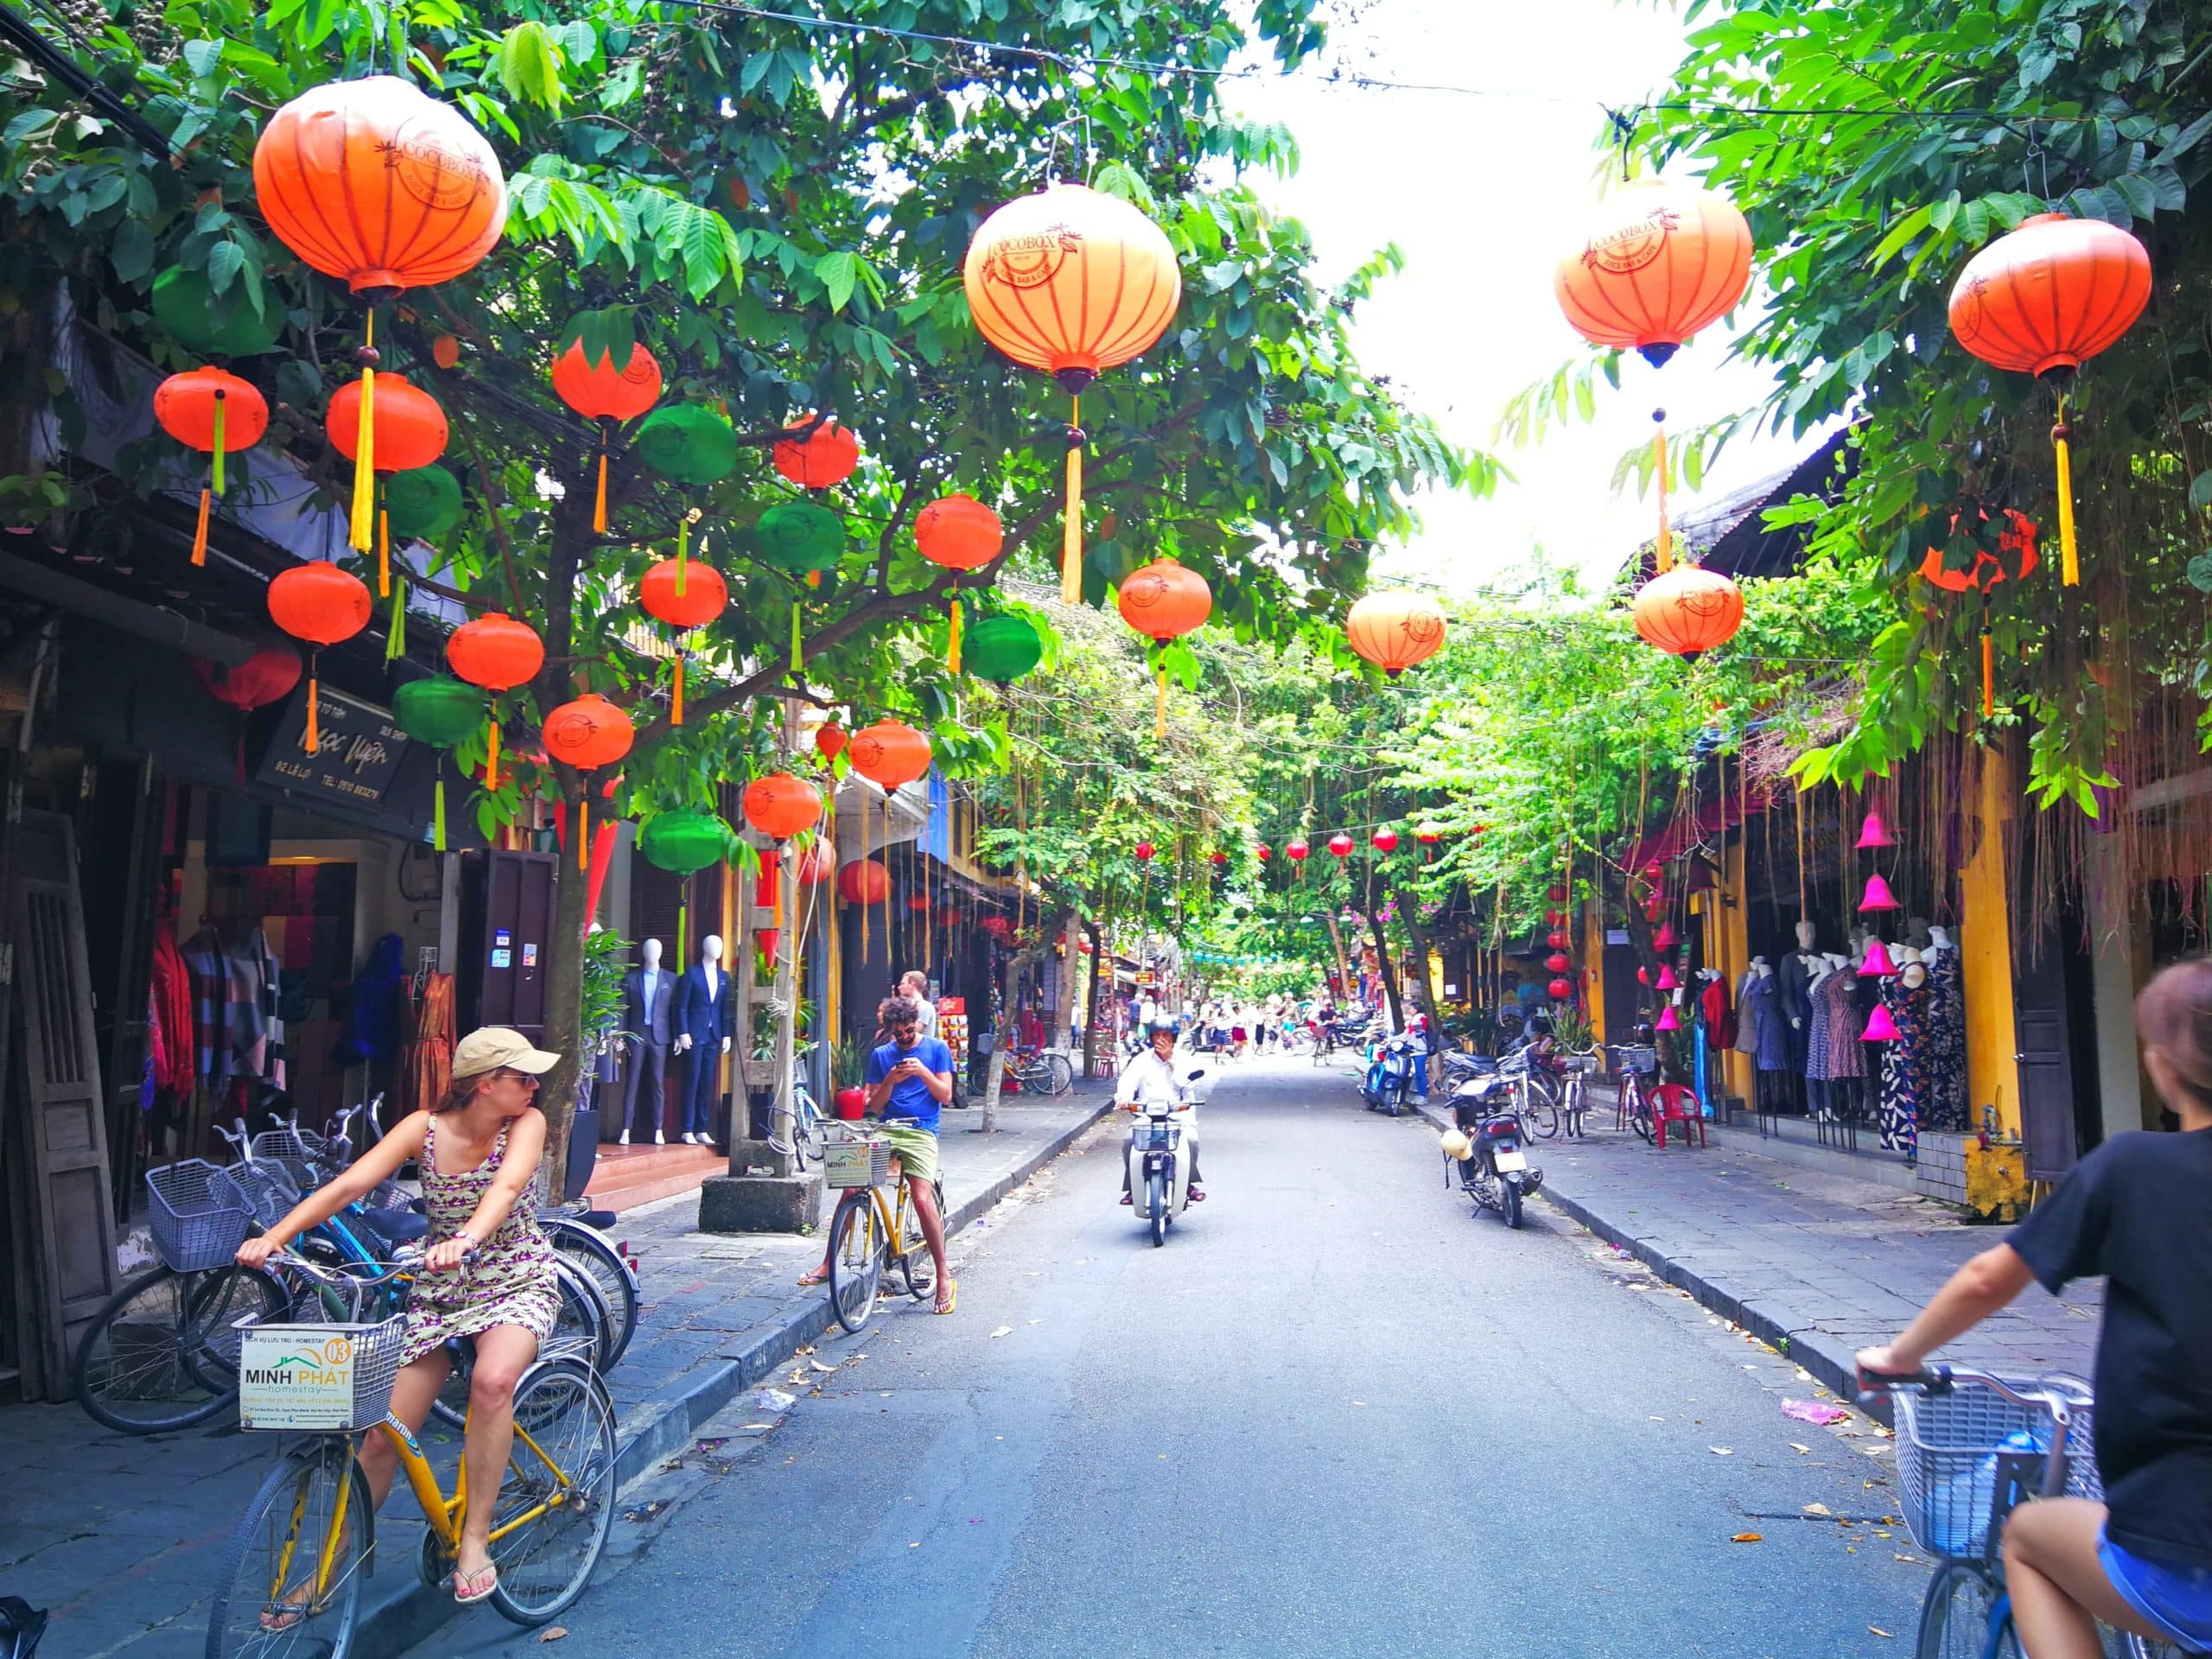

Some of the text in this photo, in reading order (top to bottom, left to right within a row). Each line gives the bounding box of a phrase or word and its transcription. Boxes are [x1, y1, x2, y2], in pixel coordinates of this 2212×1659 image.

[404, 142, 474, 181] COCOBOX
[1595, 220, 1657, 249] COCOBOX
[994, 235, 1056, 256] COCOBOX
[327, 1341, 347, 1360] 03
[245, 1367, 350, 1385] MINH PHÁT
[268, 1385, 322, 1395] homestay
[386, 1411, 412, 1441] martin
